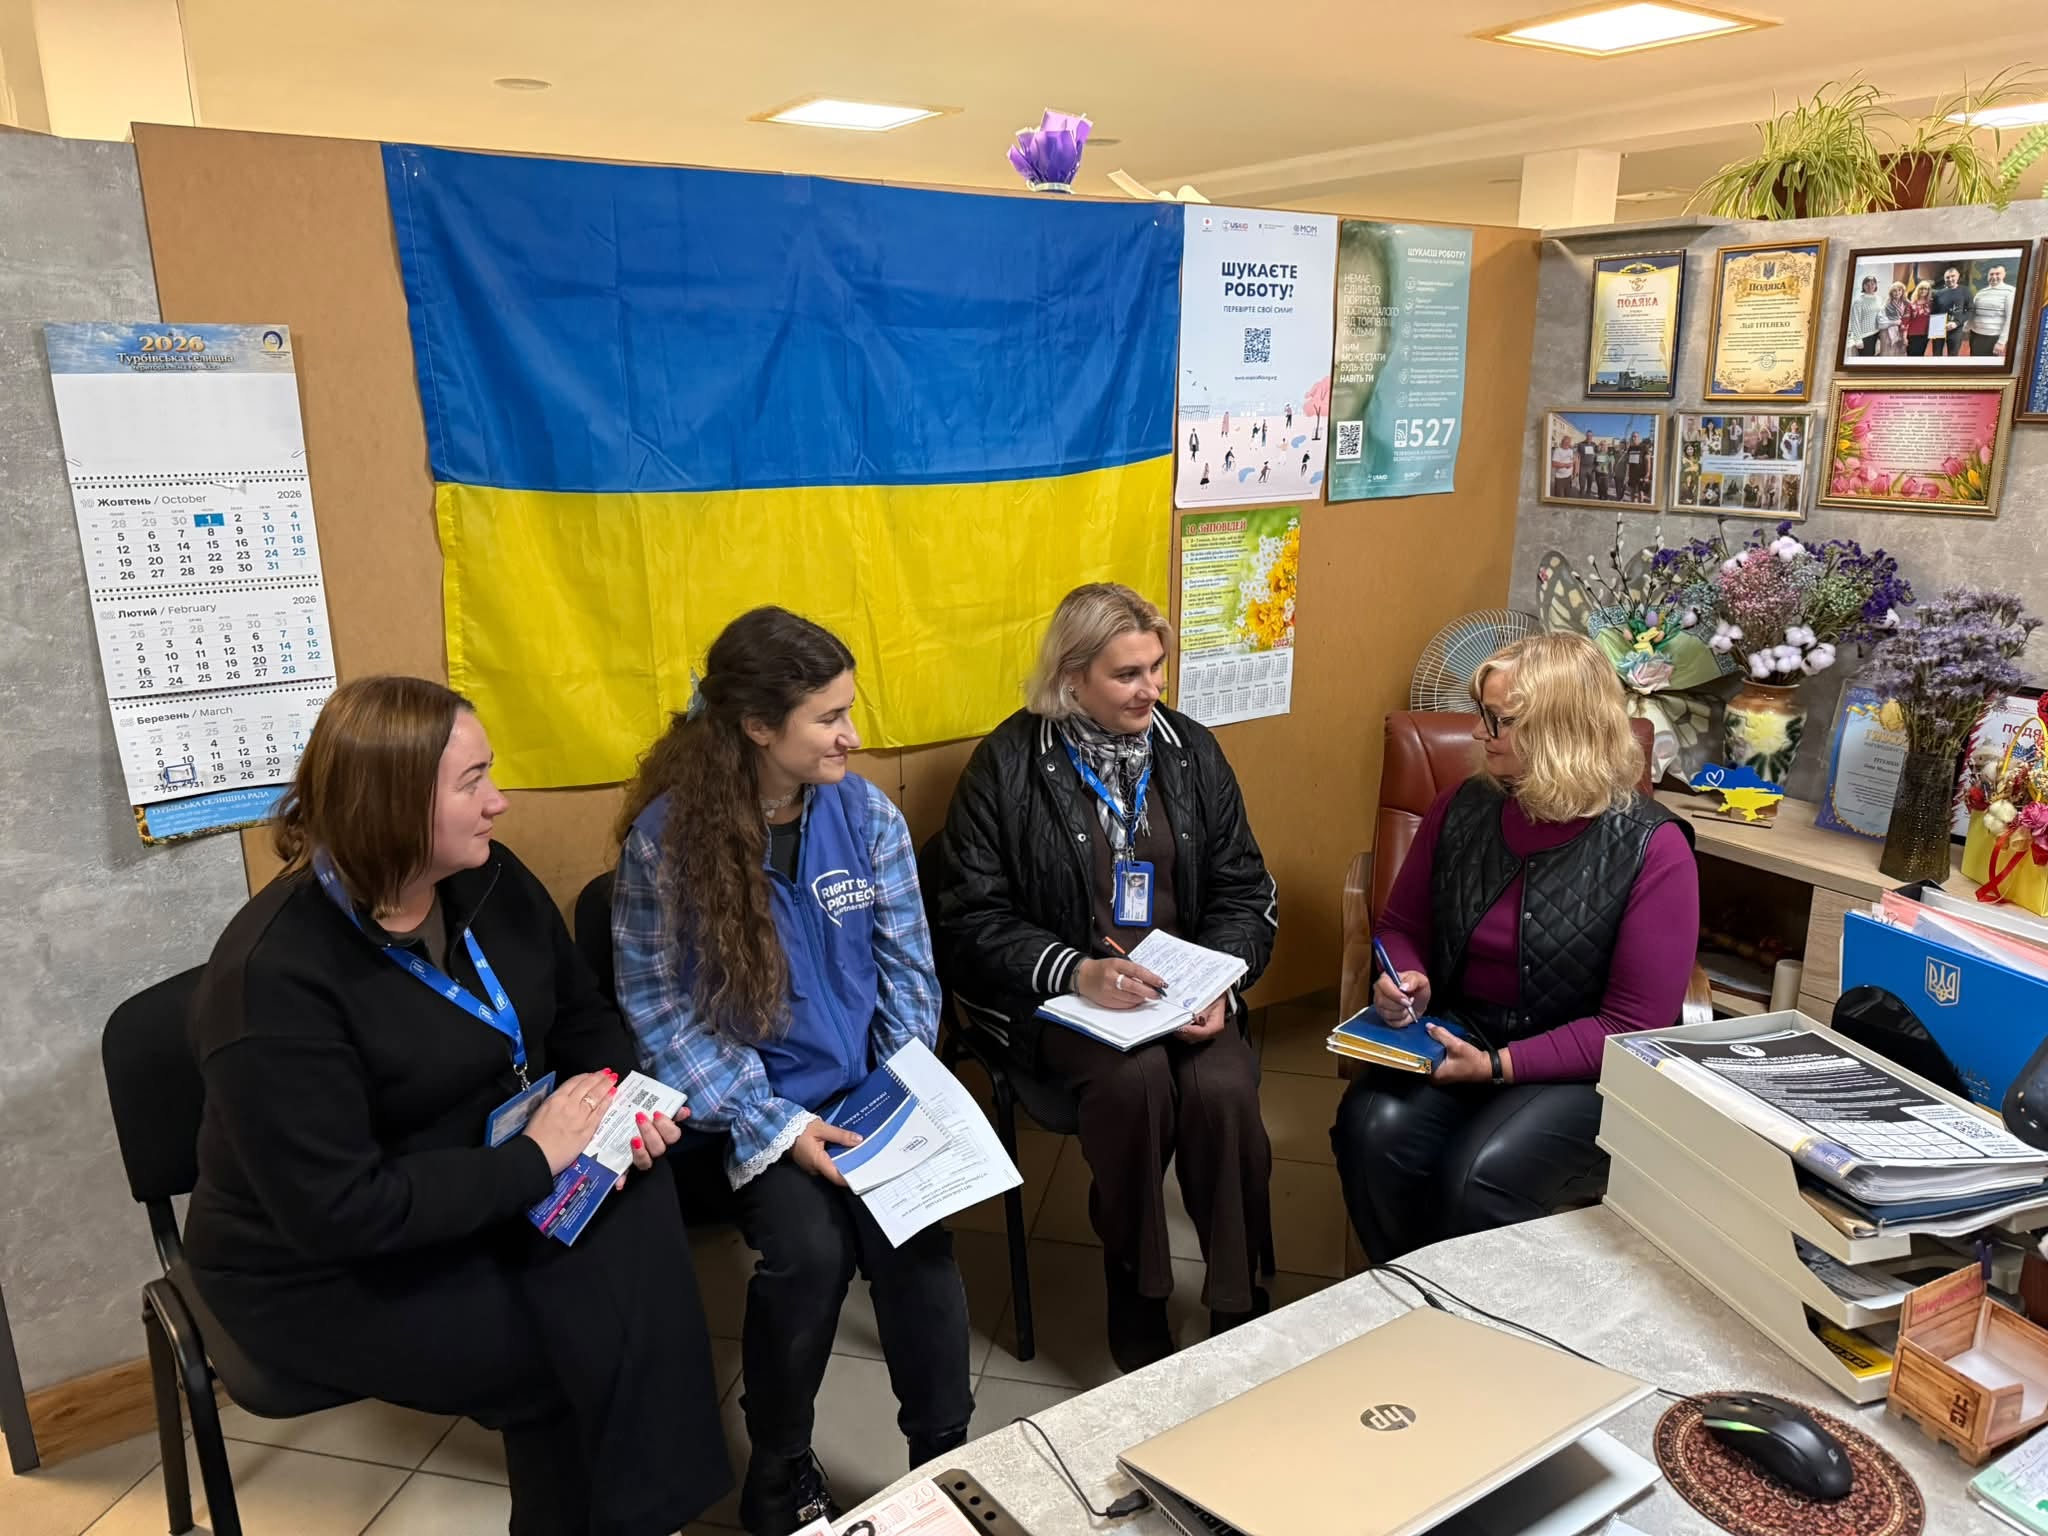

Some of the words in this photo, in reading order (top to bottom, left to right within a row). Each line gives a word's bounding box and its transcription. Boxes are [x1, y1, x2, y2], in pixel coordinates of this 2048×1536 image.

[1222, 262, 1298, 280] ШУКАЄТЕ
[1224, 282, 1294, 300] РОБОТУ?
[1749, 282, 1786, 292] ПОДЯКА
[1257, 304, 1272, 313] СВОЇ
[1617, 297, 1658, 308] ПОДЯКА
[139, 336, 204, 352] 2026
[116, 353, 185, 367] Турбівська
[1409, 418, 1456, 448] 527
[97, 498, 150, 508] Жовтень
[162, 494, 206, 504] October
[277, 490, 302, 499] 2026
[112, 520, 126, 528] 28
[142, 518, 157, 527] 29
[172, 516, 187, 526] 30
[234, 514, 242, 522] 2
[263, 512, 270, 520] 3
[118, 533, 124, 541] 5
[148, 531, 156, 539] 6
[178, 530, 184, 538] 7
[208, 528, 214, 536] 8
[236, 526, 243, 534] 9
[262, 525, 274, 533] 10
[117, 546, 130, 554] 12
[148, 544, 160, 552] 13
[178, 542, 190, 550] 14
[207, 540, 219, 548] 15
[236, 539, 248, 547] 16
[264, 537, 275, 545] 17
[292, 536, 303, 544] 18
[119, 558, 132, 567] 19
[148, 556, 163, 565] 20
[180, 555, 191, 563] 21
[208, 553, 222, 561] 22
[237, 551, 250, 560] 23
[265, 549, 278, 558] 24
[292, 548, 306, 556] 25
[120, 571, 135, 580] 26
[151, 569, 164, 578] 27
[180, 567, 195, 576] 28
[210, 566, 224, 574] 29
[238, 564, 252, 572] 30
[268, 562, 279, 570] 31
[118, 608, 157, 618] Лютий
[168, 603, 216, 615] February
[293, 596, 316, 604] 2026
[130, 630, 145, 639] 26
[160, 627, 174, 636] 27
[190, 625, 204, 634] 28
[219, 622, 232, 631] 29
[246, 620, 261, 628] 30
[136, 643, 144, 651] 2
[166, 640, 173, 648] 3
[224, 635, 231, 643] 5
[252, 632, 259, 640] 6
[280, 630, 286, 638] 7
[138, 655, 145, 663] 9
[166, 652, 178, 660] 10
[196, 650, 206, 658] 11
[224, 647, 236, 655] 12
[252, 644, 263, 652] 13
[280, 642, 291, 650] 14
[307, 639, 318, 648] 15
[138, 668, 151, 676] 16
[168, 664, 179, 673] 17
[196, 662, 209, 670] 18
[226, 659, 238, 667] 19
[252, 656, 266, 665] 20
[281, 654, 292, 662] 21
[308, 651, 320, 660] 22
[139, 680, 153, 688] 23
[169, 677, 183, 685] 24
[198, 674, 212, 682] 25
[226, 671, 240, 679] 26
[255, 668, 267, 676] 27
[282, 666, 296, 674] 28
[136, 713, 190, 724] Березень
[200, 706, 232, 717] March
[150, 735, 163, 744] 23
[176, 731, 192, 740] 24
[206, 728, 219, 736] 25
[233, 725, 247, 733] 26
[262, 721, 274, 730] 27
[2002, 723, 2042, 738] ПОДЯ
[155, 748, 162, 756] 2
[239, 736, 245, 744] 5
[158, 760, 164, 768] 9
[182, 754, 194, 764] 10
[238, 748, 250, 756] 12
[266, 745, 277, 753] 13
[212, 763, 224, 771] 18
[240, 760, 251, 768] 19
[266, 757, 280, 765] 20
[213, 775, 226, 783] 25
[240, 771, 254, 780] 26
[268, 768, 280, 776] 27
[248, 791, 269, 800] РАДА
[821, 879, 854, 900] RIGHT
[856, 878, 868, 889] to
